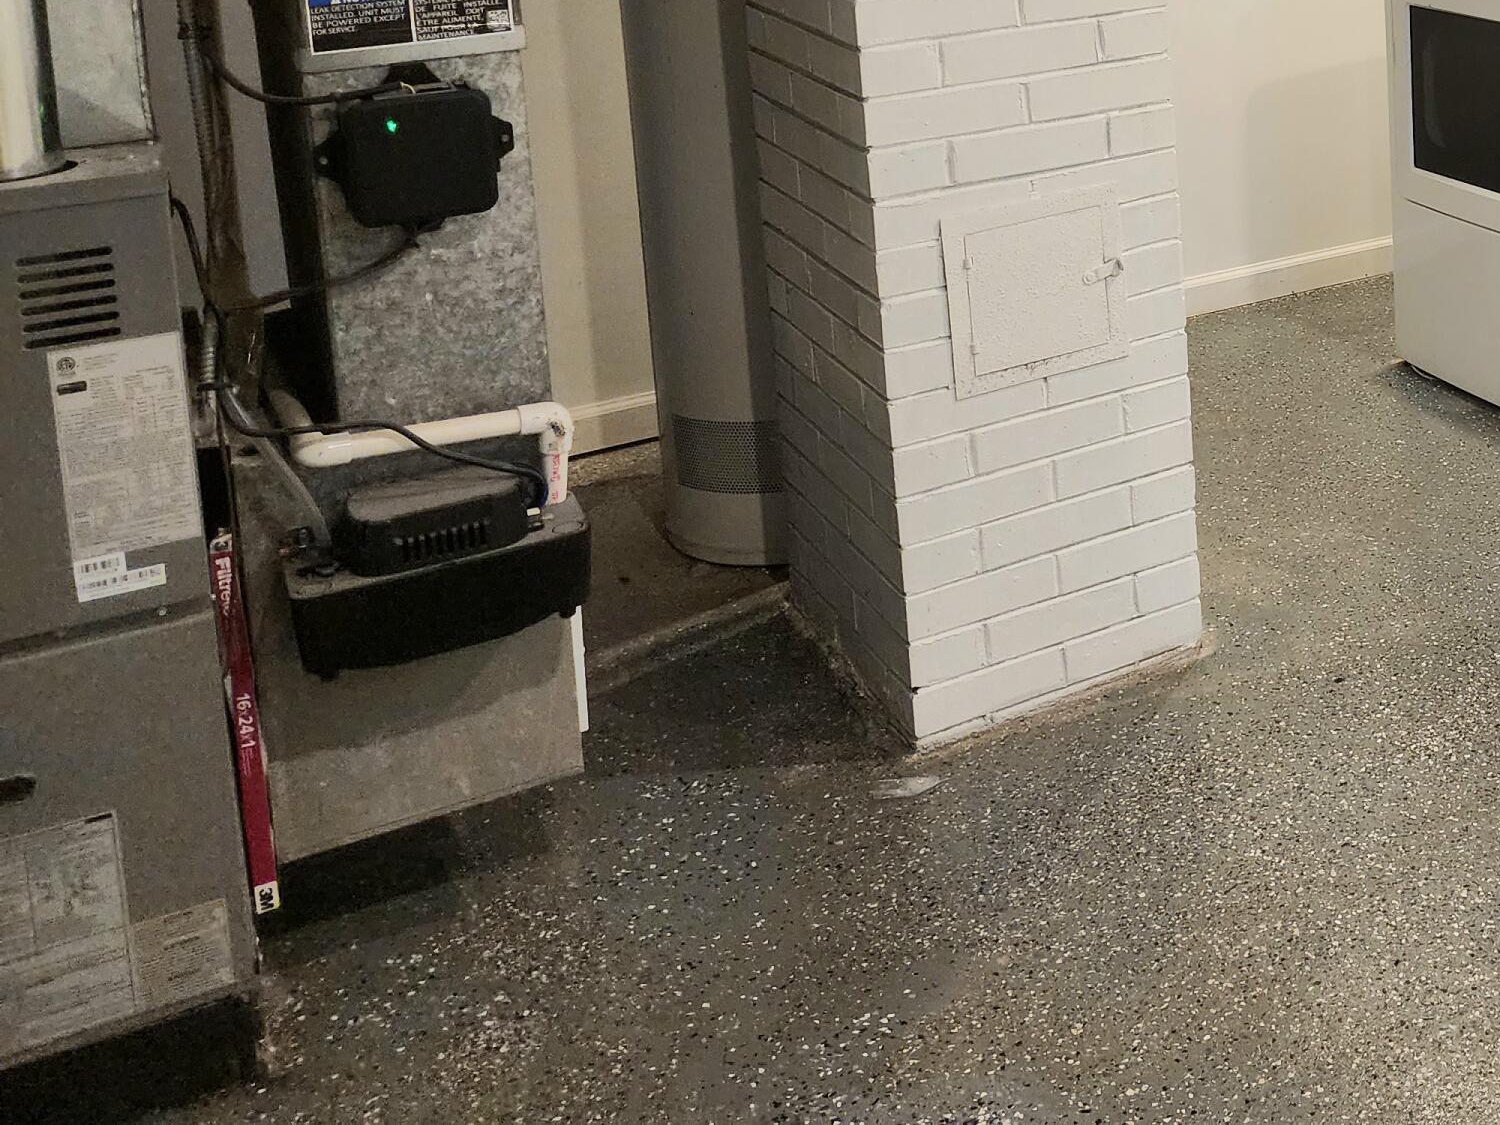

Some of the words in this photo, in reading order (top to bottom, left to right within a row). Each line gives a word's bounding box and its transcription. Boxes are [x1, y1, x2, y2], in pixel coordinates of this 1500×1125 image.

[310, 5, 330, 14] LEAK
[331, 2, 374, 13] DETECTION
[376, 0, 406, 8] SYSTEM
[358, 9, 379, 17] UNIT
[380, 6, 405, 15] MUST
[415, 6, 428, 14] DE
[432, 3, 457, 12] FUITE
[464, 6, 485, 15] DOIT
[312, 21, 323, 29] BE
[326, 16, 372, 26] POWERED
[373, 13, 406, 23] EXCEPT
[236, 693, 257, 749] 16x24x1
[259, 887, 275, 911] 3M
